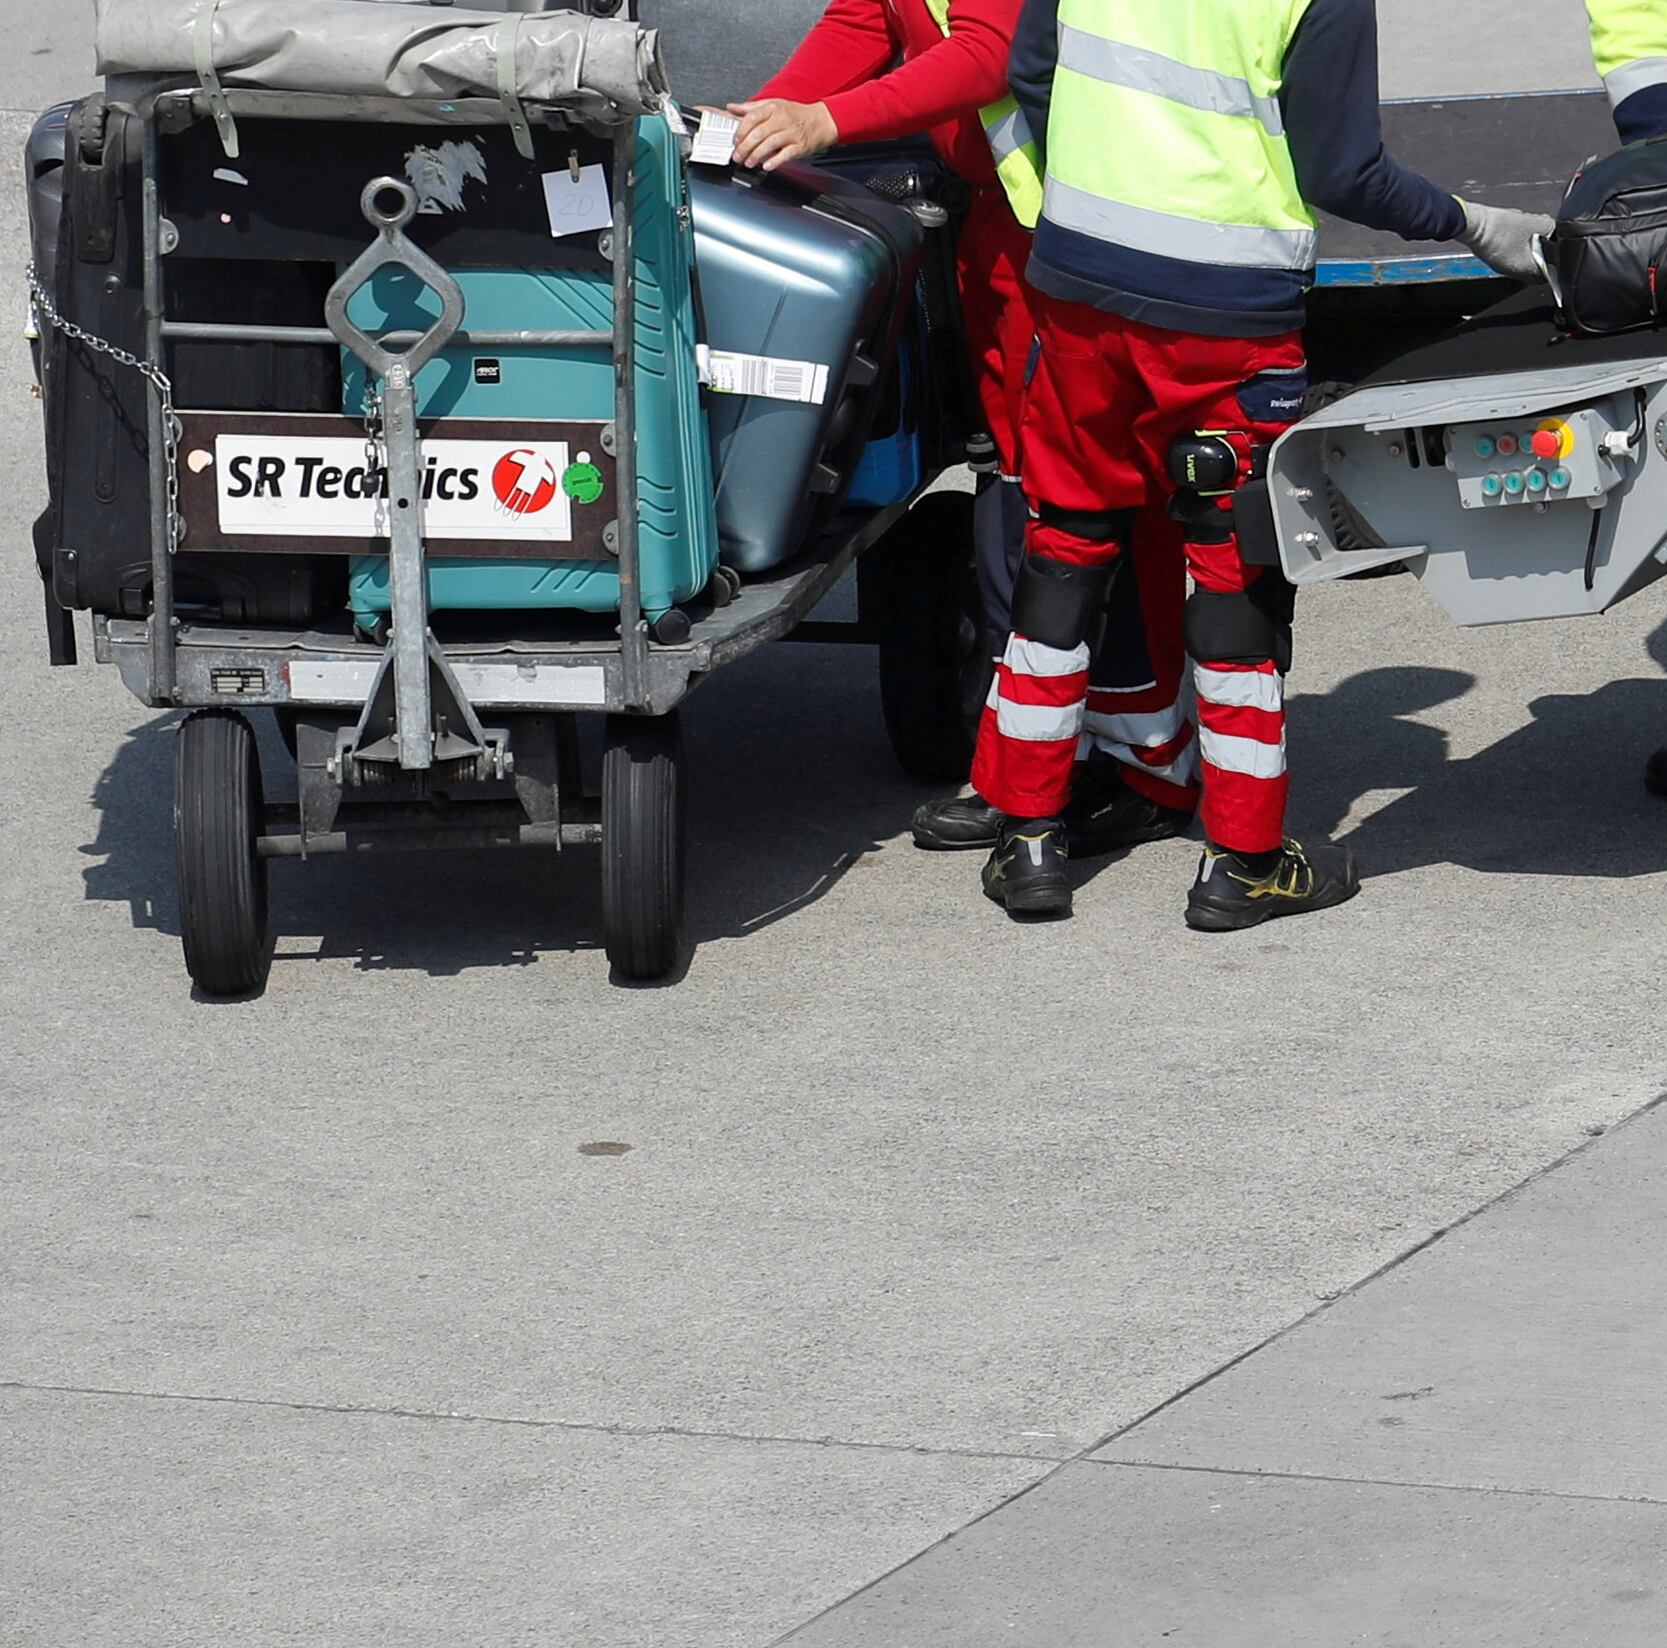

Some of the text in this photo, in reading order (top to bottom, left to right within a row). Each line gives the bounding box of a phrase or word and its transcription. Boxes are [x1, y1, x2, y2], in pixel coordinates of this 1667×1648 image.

[558, 193, 594, 217] 20
[227, 455, 480, 501] SR Techics
[1186, 454, 1197, 483] uvex
